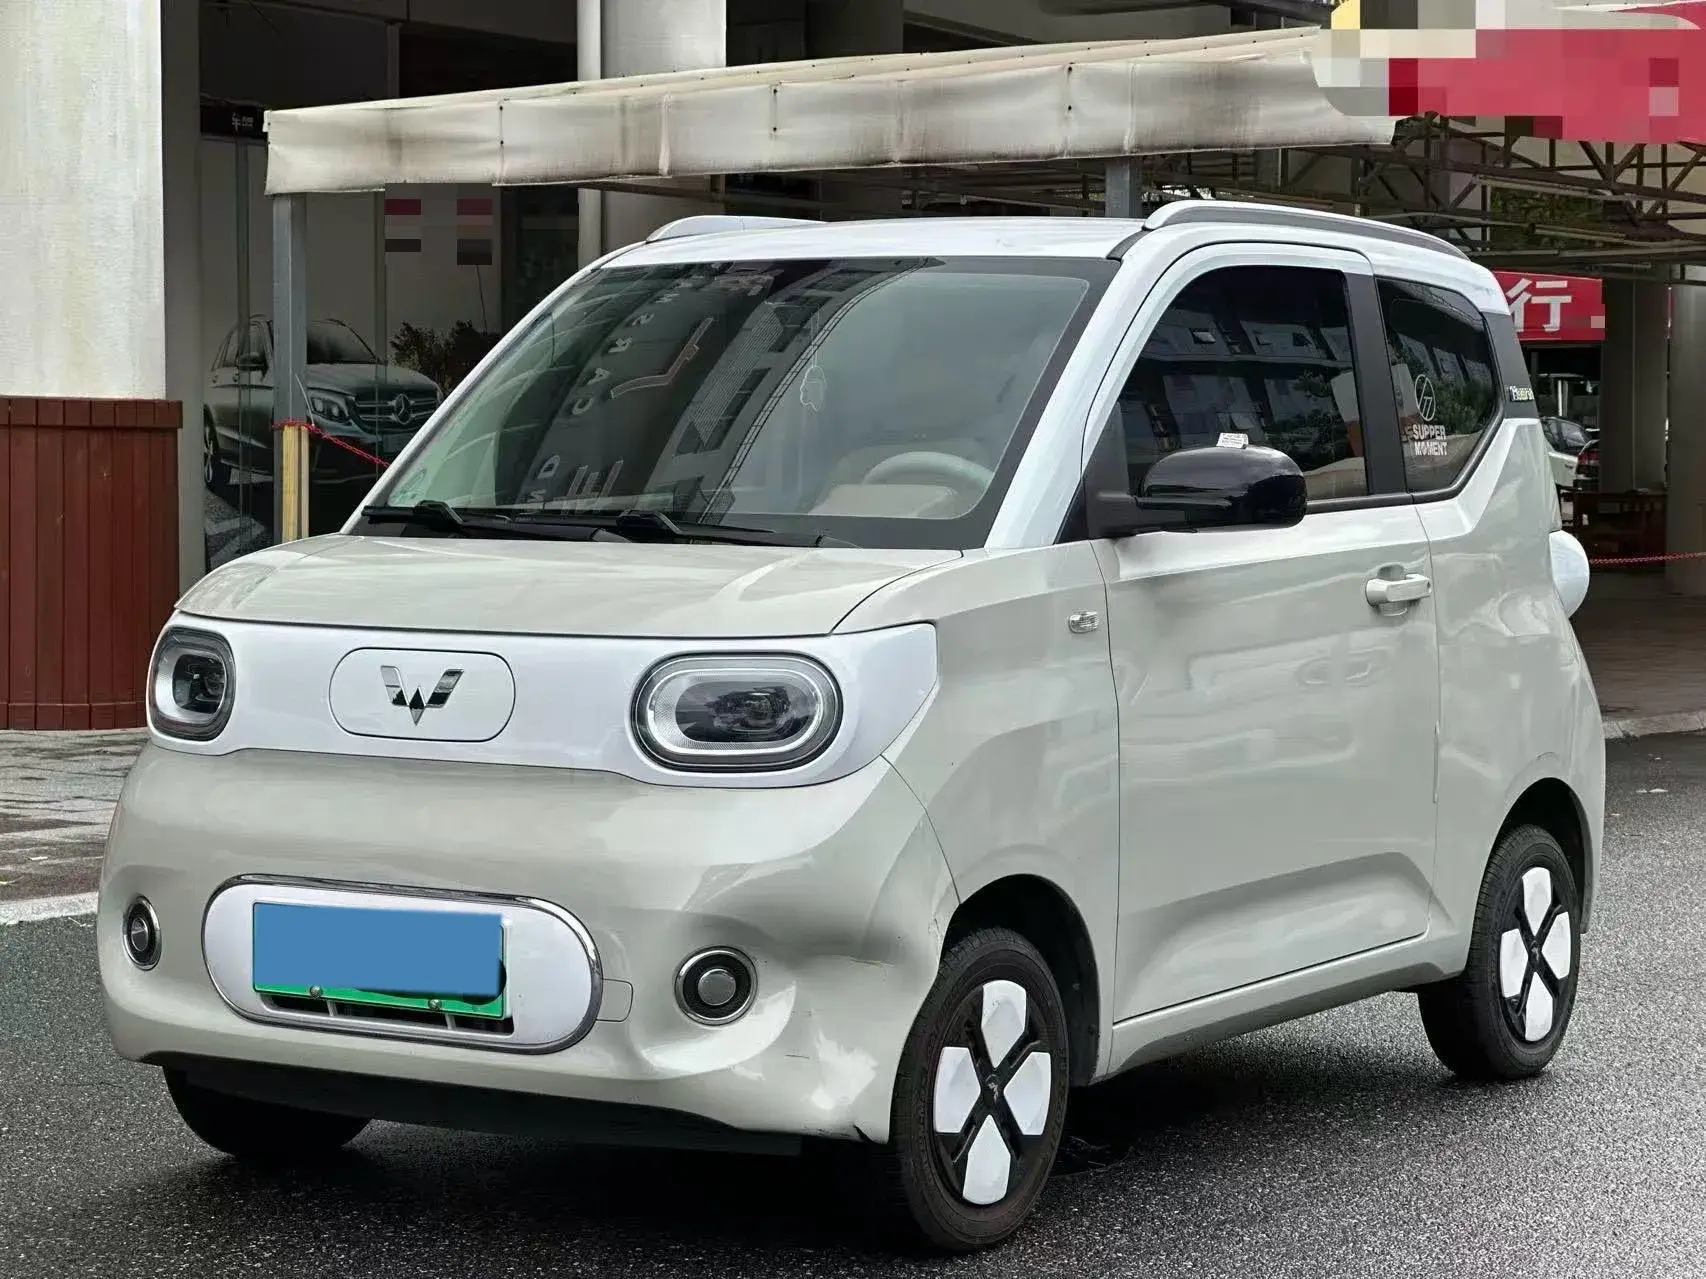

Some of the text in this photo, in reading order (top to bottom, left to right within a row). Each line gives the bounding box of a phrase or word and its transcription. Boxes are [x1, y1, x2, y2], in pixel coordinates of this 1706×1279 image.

[1505, 277, 1573, 333] 行
[1412, 423, 1447, 440] SUPPER
[1414, 441, 1448, 456] MOMENT
